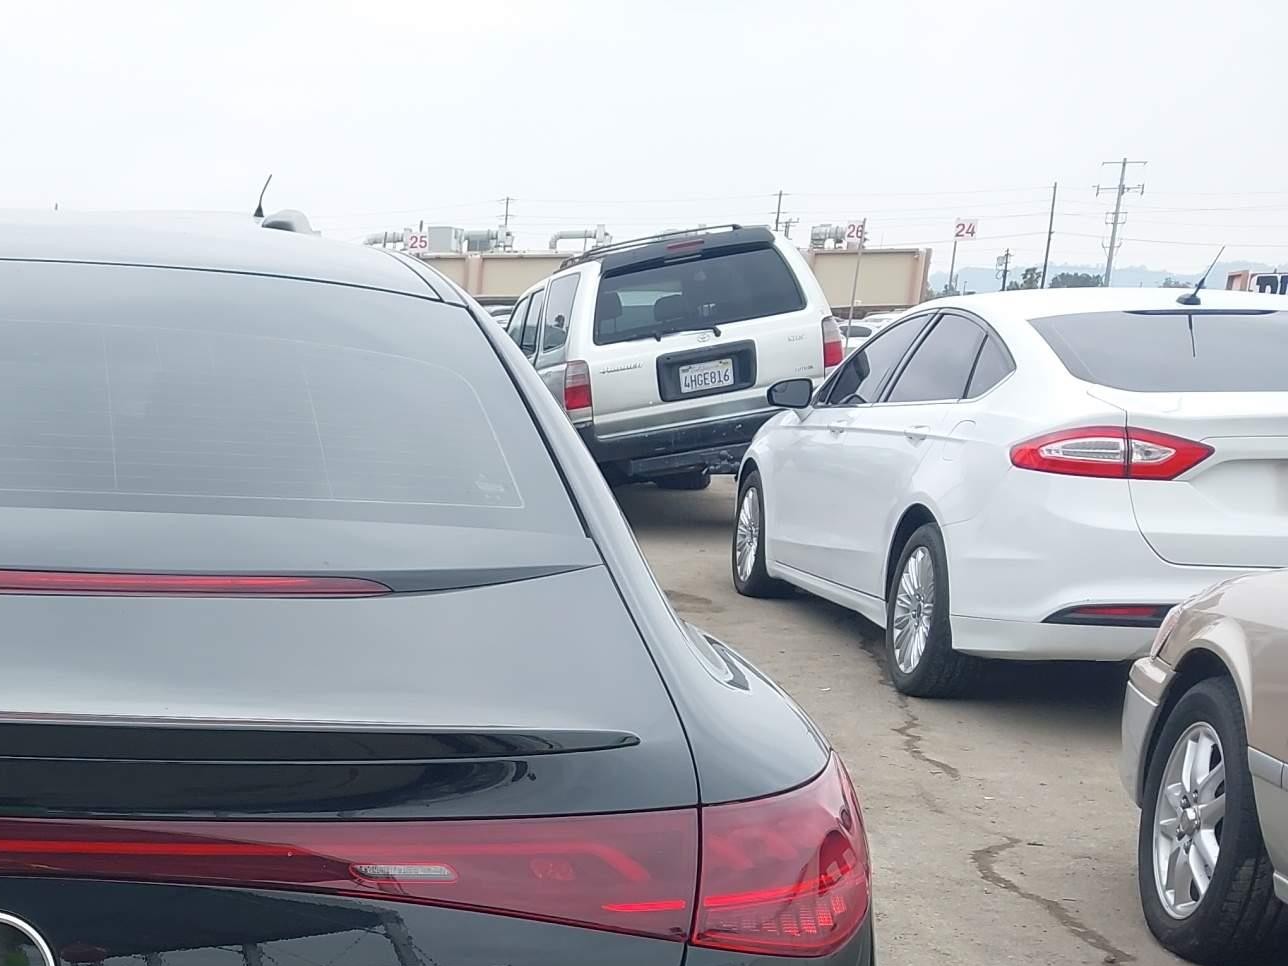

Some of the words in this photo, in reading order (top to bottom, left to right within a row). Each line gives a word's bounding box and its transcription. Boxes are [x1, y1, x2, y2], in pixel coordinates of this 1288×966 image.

[955, 223, 976, 237] 24
[409, 235, 427, 248] 25
[684, 368, 730, 389] 4HGE816
